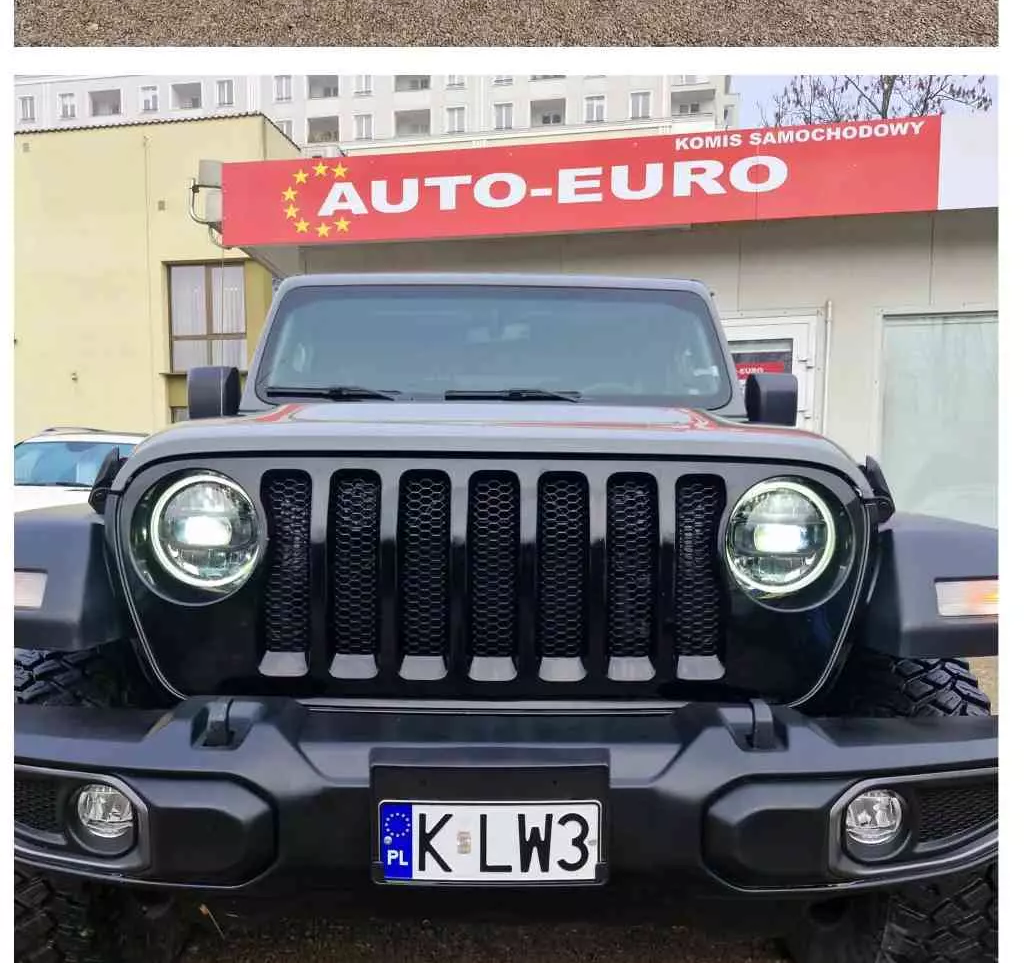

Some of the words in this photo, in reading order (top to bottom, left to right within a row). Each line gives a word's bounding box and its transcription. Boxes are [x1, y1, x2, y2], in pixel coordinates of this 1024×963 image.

[675, 134, 742, 151] KOMIS
[749, 121, 925, 146] SAMOCHODOWY
[317, 154, 788, 217] AUTO-EURO
[387, 849, 409, 866] PL
